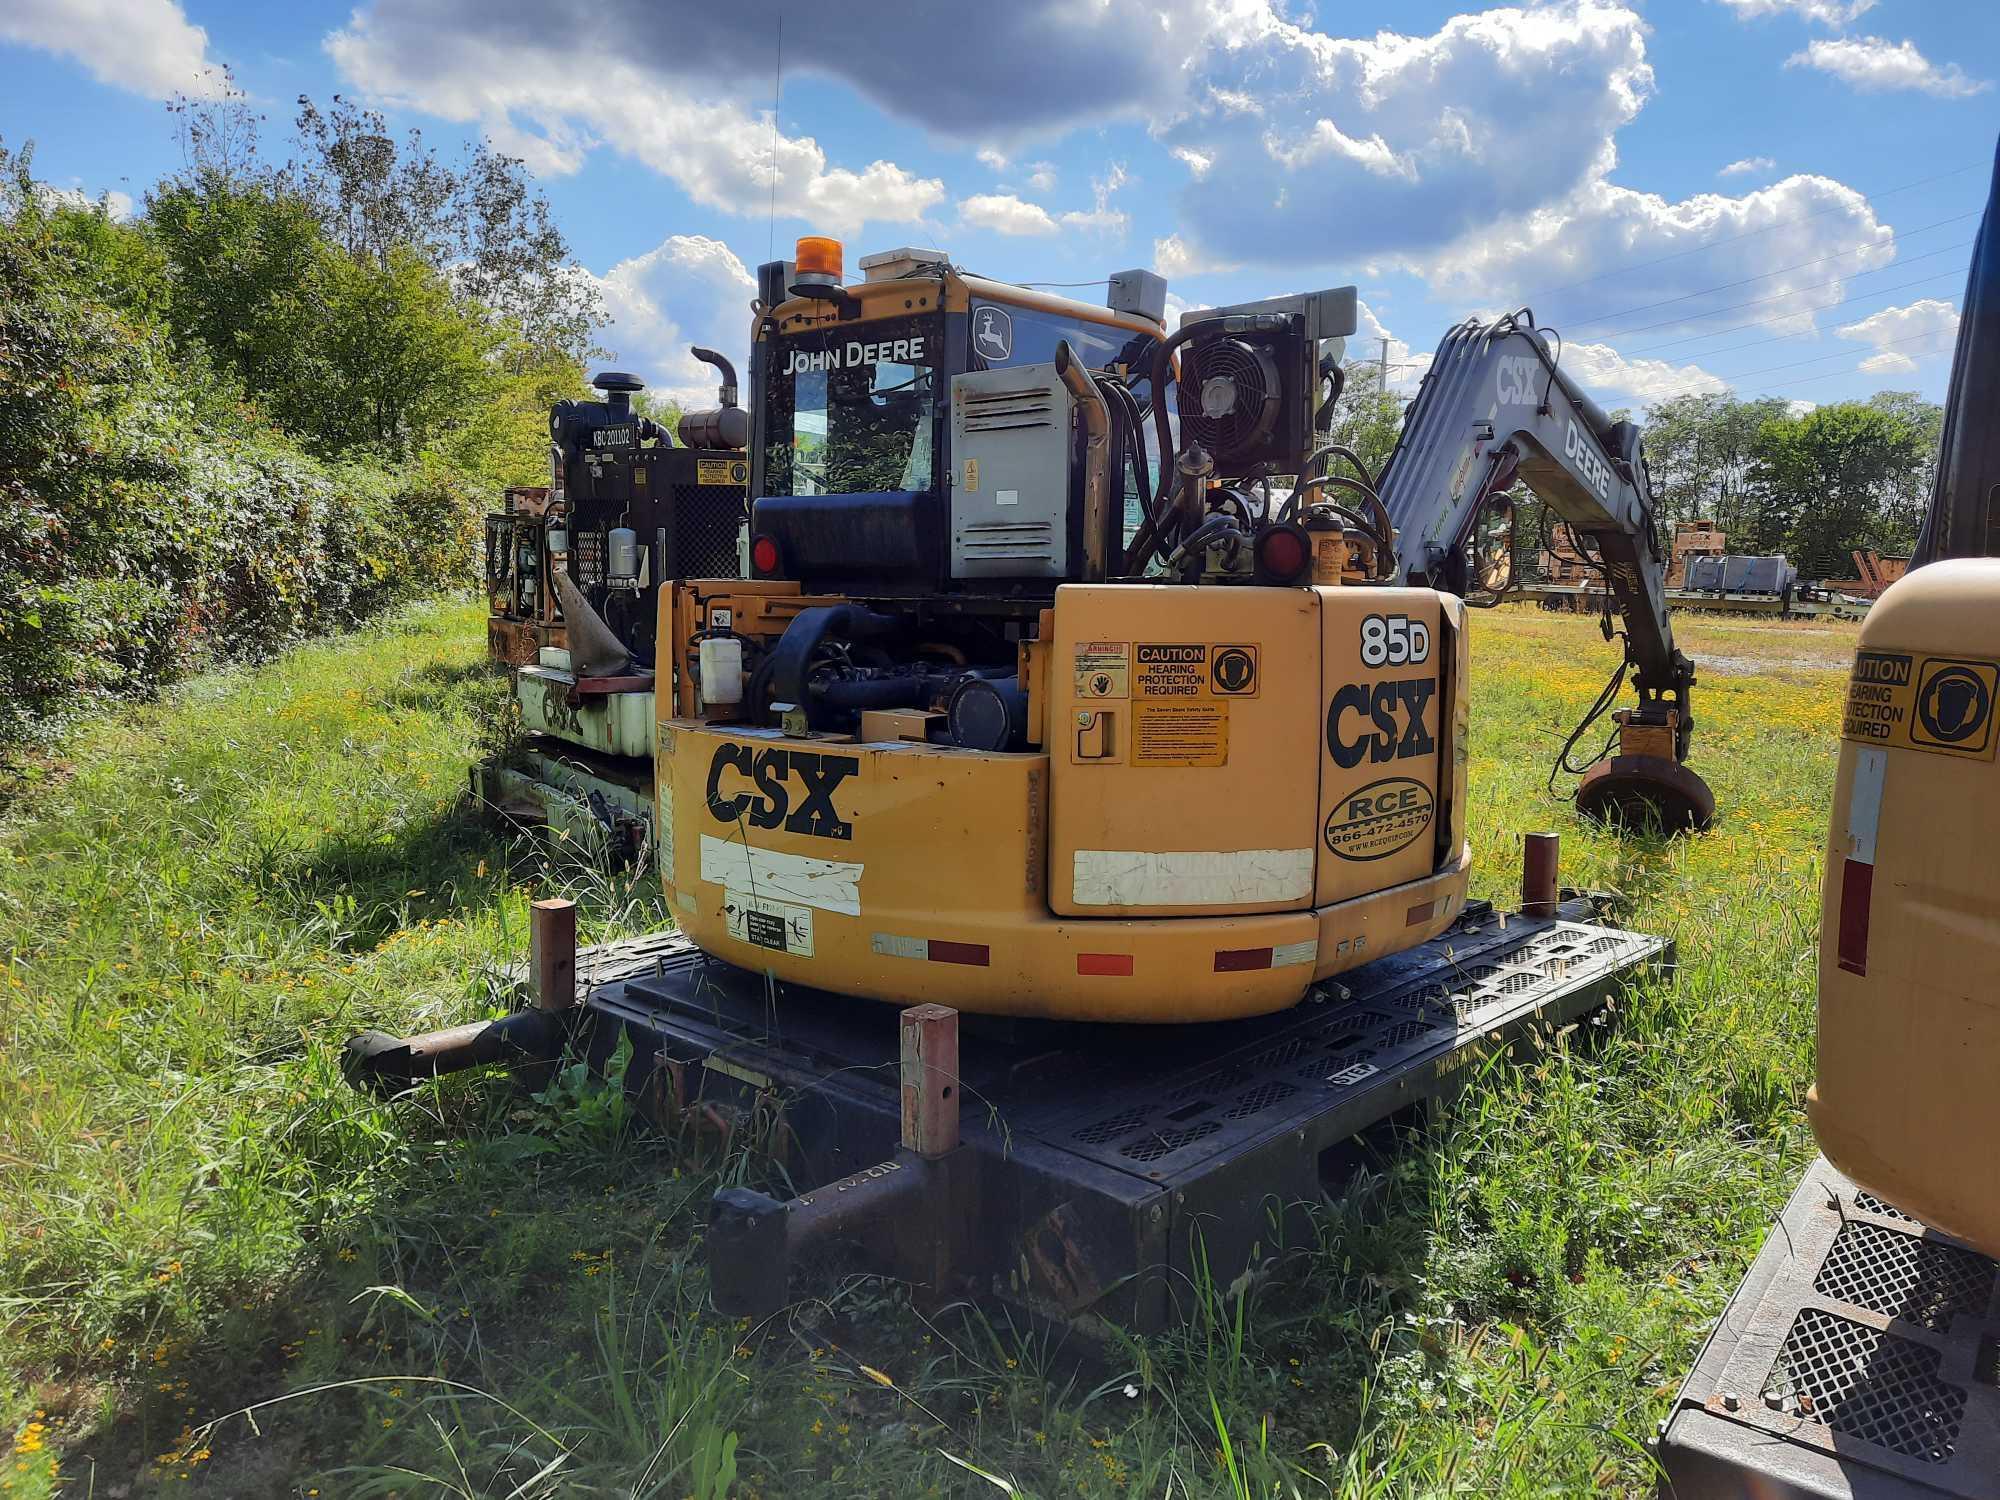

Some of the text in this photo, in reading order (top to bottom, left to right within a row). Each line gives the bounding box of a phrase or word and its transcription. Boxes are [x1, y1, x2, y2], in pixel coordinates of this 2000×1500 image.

[783, 336, 925, 375] JOHN DEERE
[1497, 355, 1538, 406] CSX
[593, 428, 630, 446] KBC 201102
[1564, 418, 1610, 500] DEERE
[1360, 614, 1431, 669] 85D
[1139, 648, 1205, 662] CAUTION
[1137, 675, 1205, 685] PROTECTION
[1148, 665, 1195, 674] HEARING
[1857, 658, 1910, 682] UTION
[1144, 686, 1198, 696] REQUIRED
[1851, 685, 1892, 702] EARING
[1327, 678, 1435, 768] CSX
[1846, 701, 1904, 723] OTECTION
[706, 742, 859, 841] CSX
[1348, 787, 1418, 820] RCE
[1331, 814, 1429, 845] 866-472-4570
[1331, 1064, 1373, 1084] STEP
